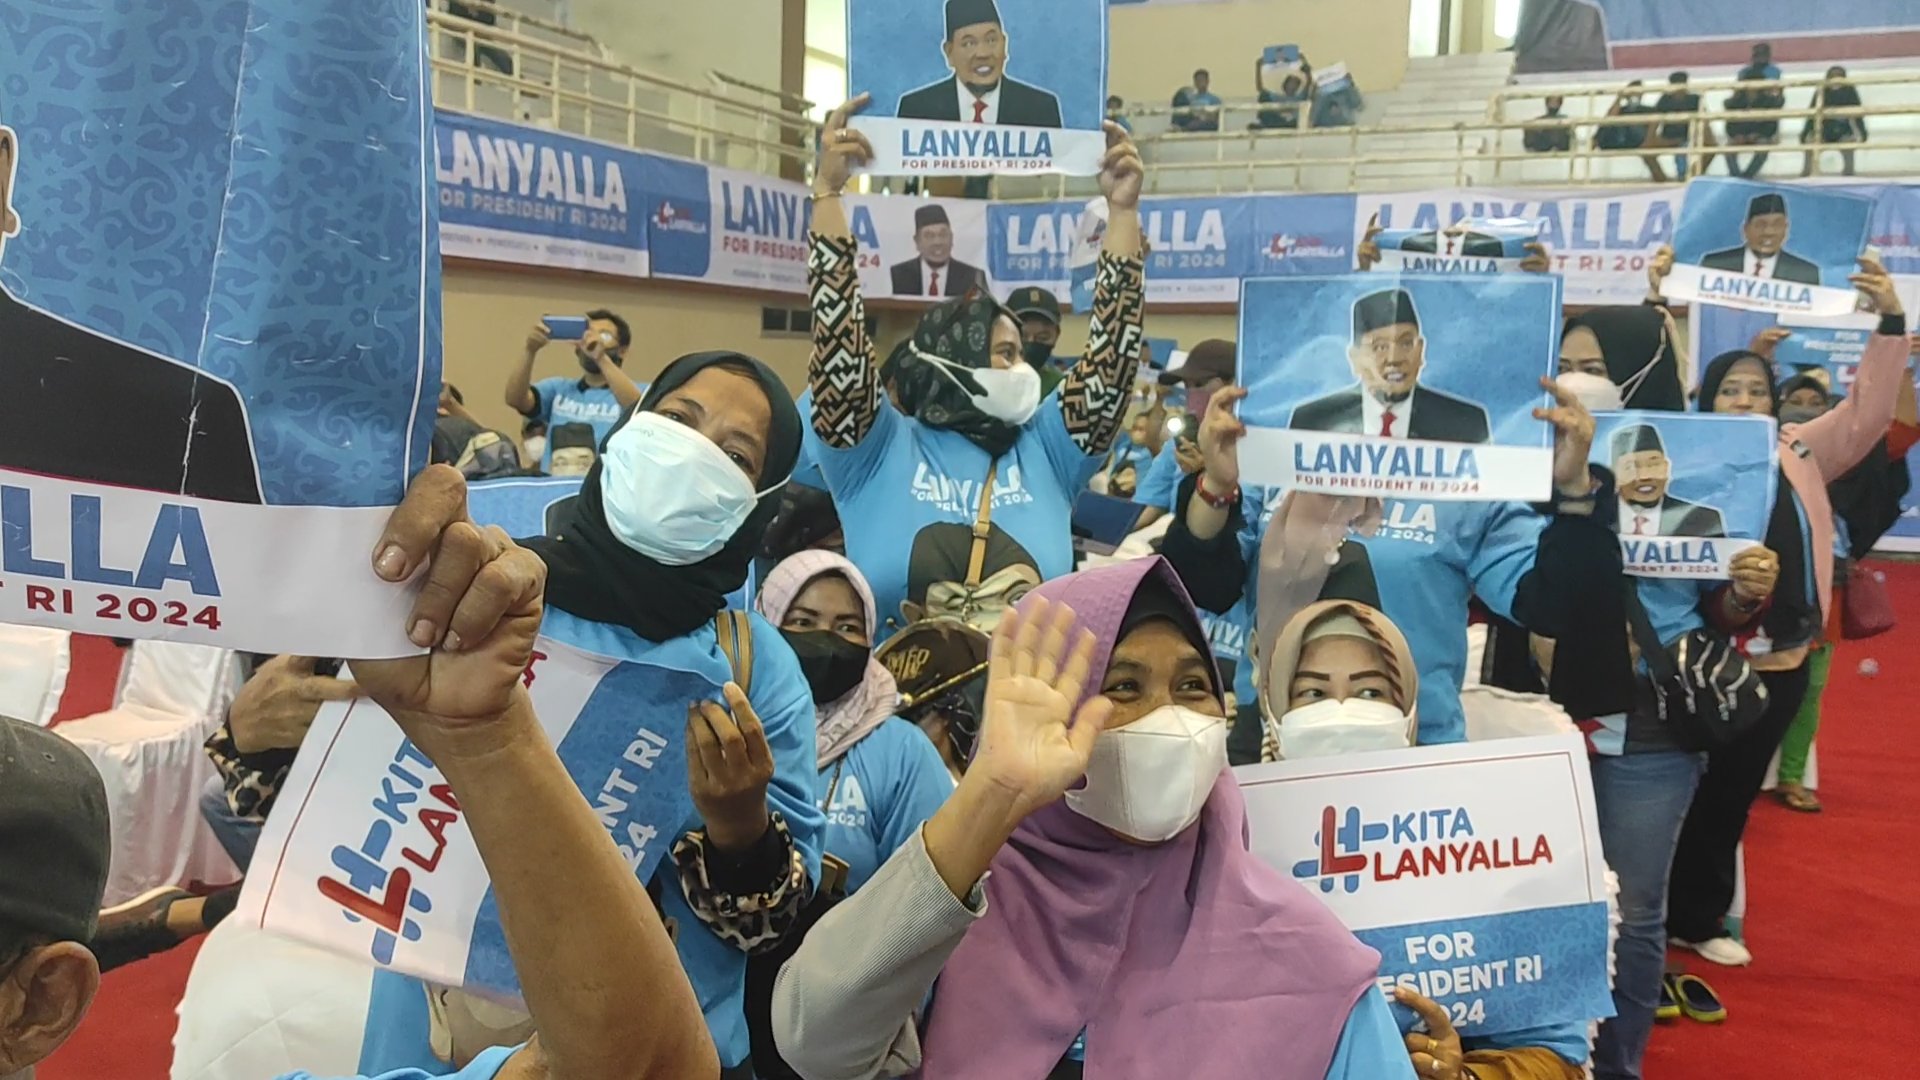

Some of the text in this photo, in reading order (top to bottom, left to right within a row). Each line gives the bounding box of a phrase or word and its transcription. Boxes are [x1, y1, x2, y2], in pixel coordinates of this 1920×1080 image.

[901, 129, 1053, 158] LANYALLA
[433, 127, 628, 214] LANYALLA
[901, 159, 928, 169] FOR
[1022, 160, 1052, 169] 2024
[440, 187, 466, 209] OR
[472, 193, 564, 222] PRESIDENT
[588, 211, 627, 234] 2024
[722, 235, 750, 252] FOR
[753, 240, 807, 263] PRESIDE
[1007, 254, 1042, 270] FOR
[1155, 253, 1173, 269] RI
[1178, 253, 1226, 269] 2024
[1579, 255, 1604, 271] RI
[1401, 257, 1498, 274] LANYALLA
[1699, 274, 1812, 304] LANYALLA
[1294, 442, 1480, 479] LANYALLA
[1296, 474, 1480, 494] FOR PRESIDENT RI 2024
[1391, 530, 1436, 545] 2024
[1624, 541, 1718, 563] YALLA
[26, 584, 221, 630] RI 2024
[622, 727, 669, 770] RI
[828, 811, 866, 826] 2024
[1392, 806, 1474, 844] KITA
[1373, 834, 1553, 882] LANYALLA
[1405, 931, 1476, 964] FOR
[1380, 954, 1543, 1001] ESIDENT RI
